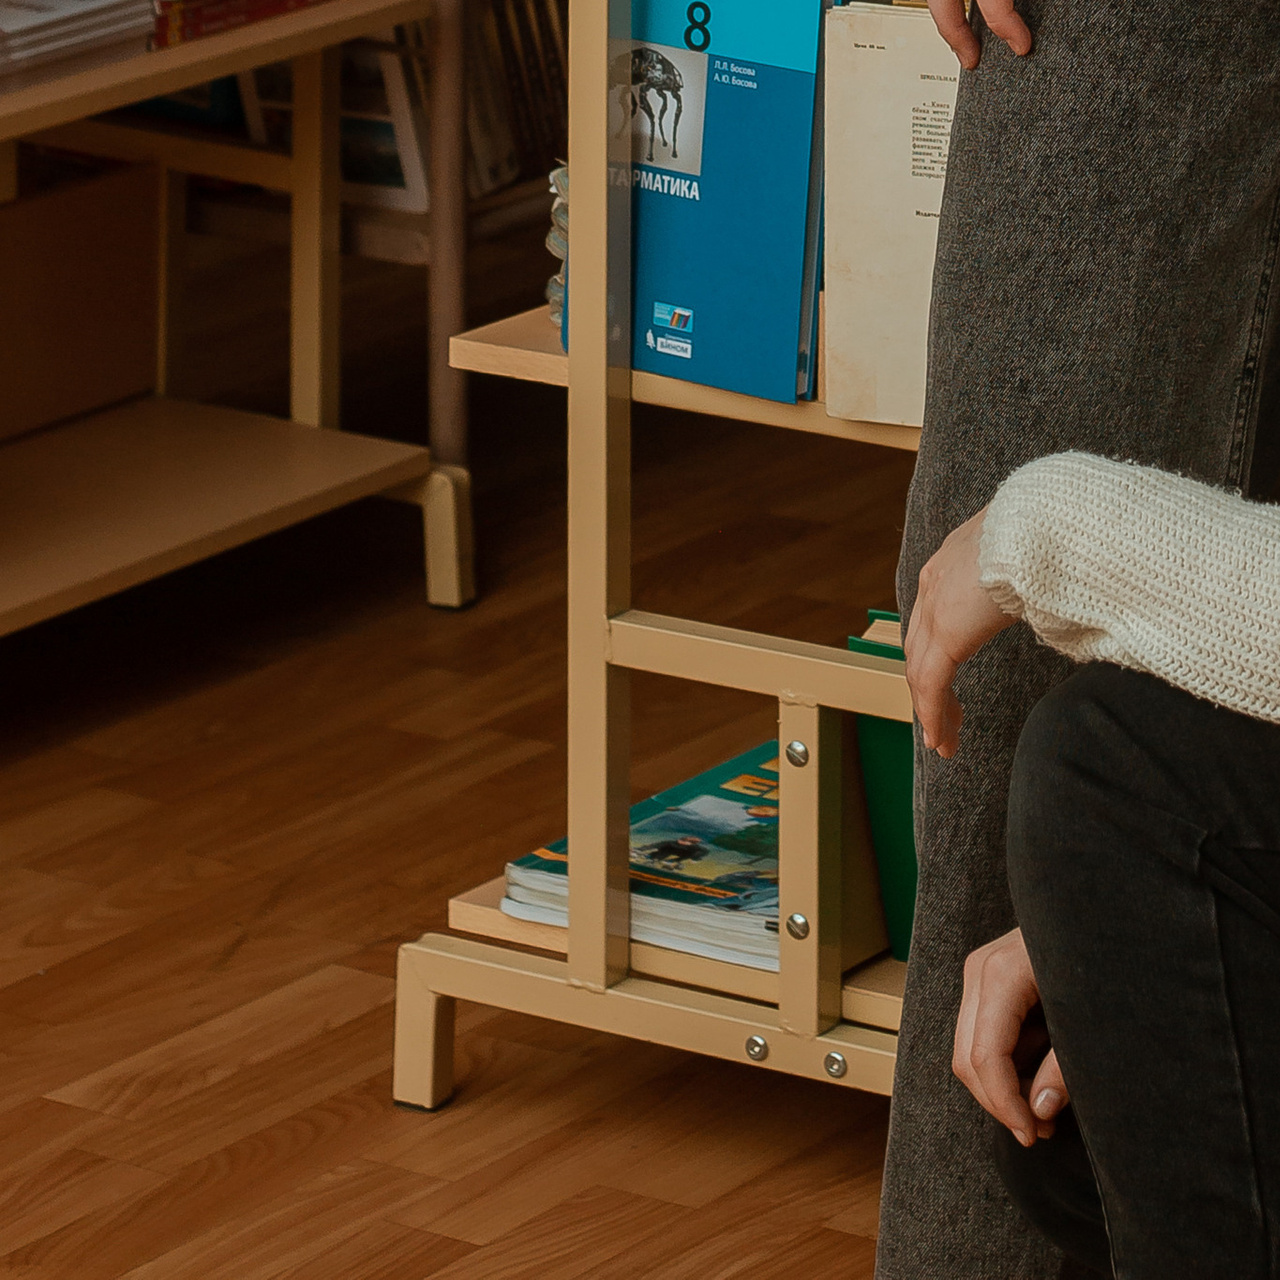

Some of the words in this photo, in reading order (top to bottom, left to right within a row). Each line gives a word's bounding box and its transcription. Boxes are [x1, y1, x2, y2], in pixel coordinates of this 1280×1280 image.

[682, 1, 712, 53] 8
[730, 63, 756, 77] Босова
[731, 75, 758, 90] Босова
[631, 169, 700, 201] РМАТИКА
